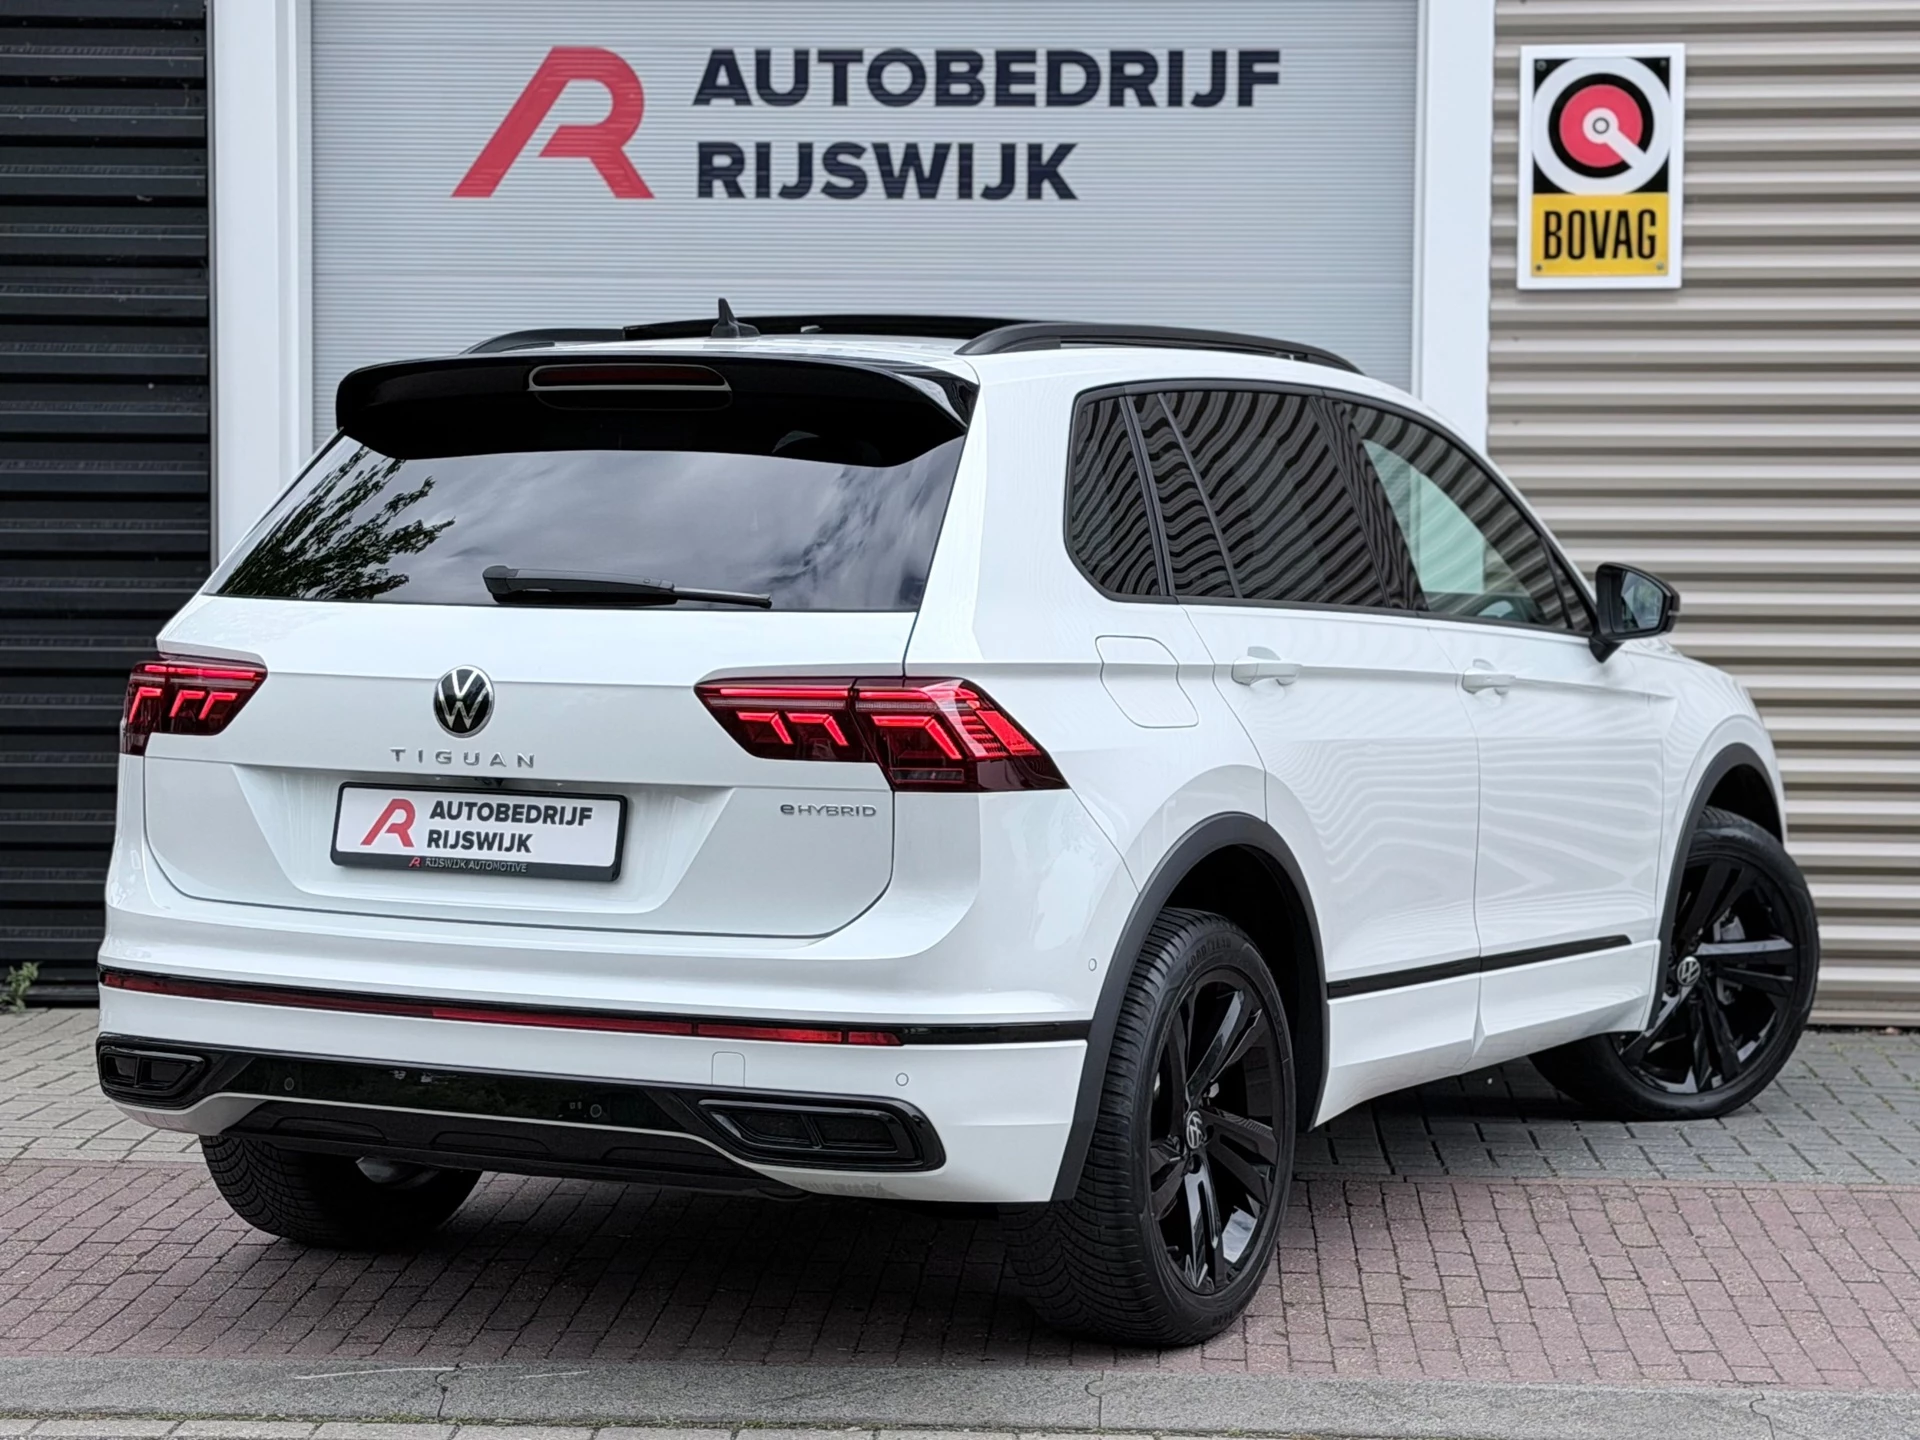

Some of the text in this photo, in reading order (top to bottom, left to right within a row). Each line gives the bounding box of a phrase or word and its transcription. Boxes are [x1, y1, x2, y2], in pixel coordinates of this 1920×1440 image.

[692, 48, 1281, 108] AUTOBEDRIJF
[697, 141, 1079, 200] RIJSWIJK
[1543, 208, 1657, 261] BOVAG
[389, 747, 535, 769] TIGUAN
[429, 800, 593, 827] AUTOBEDRIJF
[426, 829, 533, 853] RIJSWIJK
[425, 857, 467, 869] RIJSWIJK
[468, 860, 528, 873] AUTOMOTIVE
